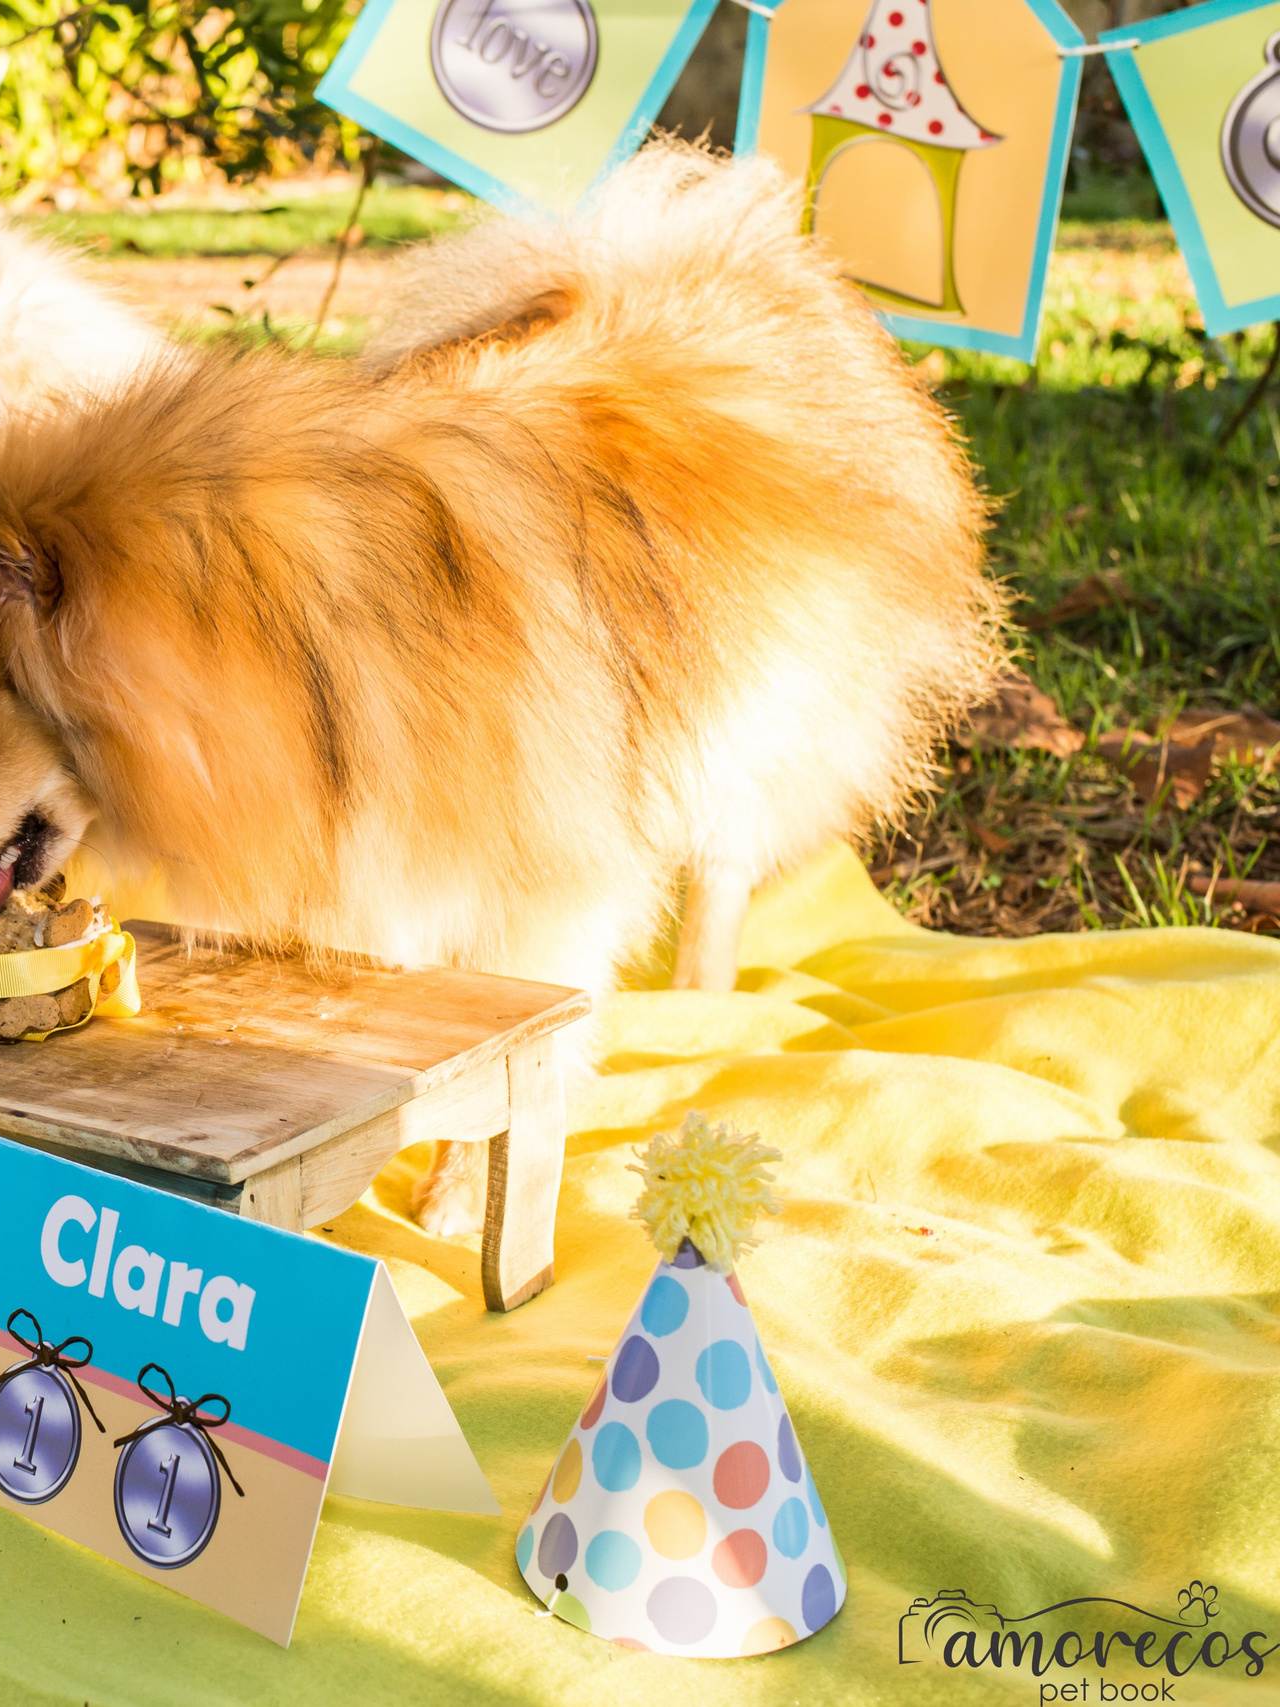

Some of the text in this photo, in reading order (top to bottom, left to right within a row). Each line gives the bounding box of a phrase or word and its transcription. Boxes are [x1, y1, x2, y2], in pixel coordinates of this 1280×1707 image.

[455, 0, 572, 99] love
[40, 1194, 257, 1352] Clara
[12, 1394, 46, 1477] 1
[146, 1452, 181, 1539] 1
